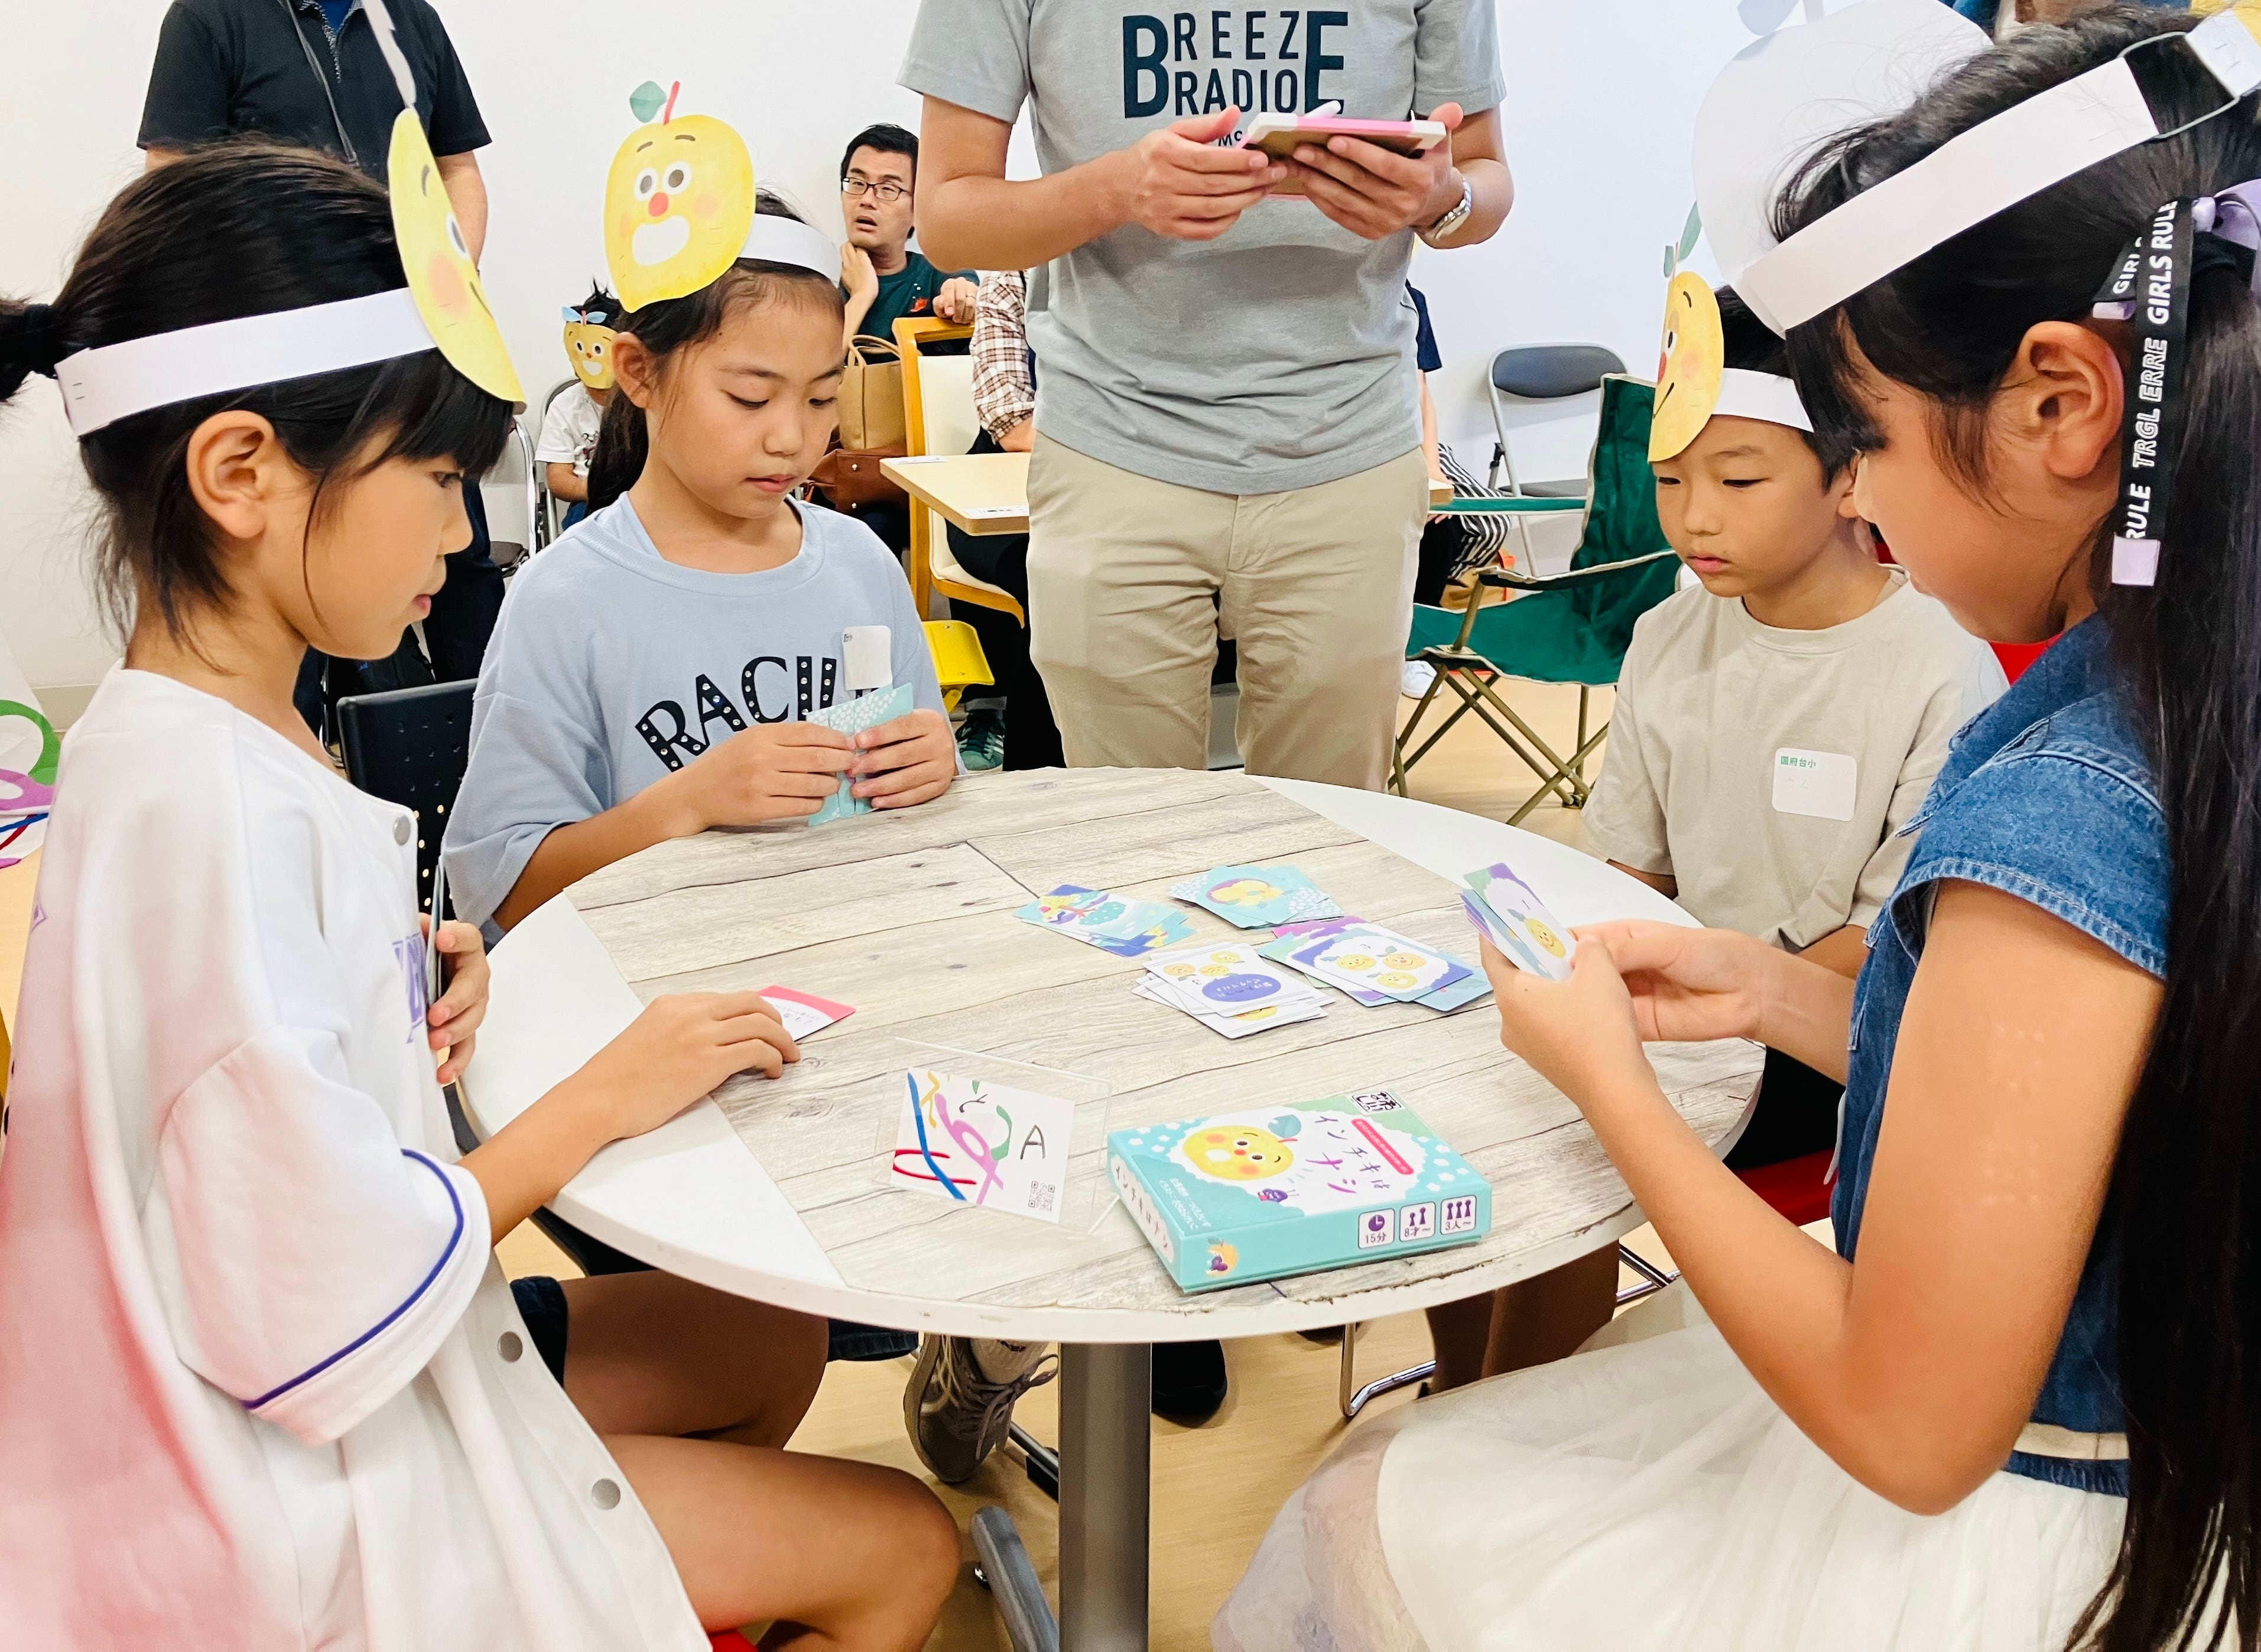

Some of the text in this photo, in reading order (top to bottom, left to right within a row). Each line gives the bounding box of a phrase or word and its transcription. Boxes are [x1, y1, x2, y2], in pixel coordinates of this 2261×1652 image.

[1122, 10, 1349, 119] BREEZE
[1175, 68, 1298, 116] RADIO
[2151, 200, 2178, 249] RULE
[2147, 255, 2173, 324] GIRLS
[2139, 337, 2168, 402] ERRE
[2132, 408, 2161, 468] TRGL
[1020, 1124, 1045, 1160] A
[1314, 1116, 1391, 1189] インチキは
[1365, 1231, 1387, 1243] 15分
